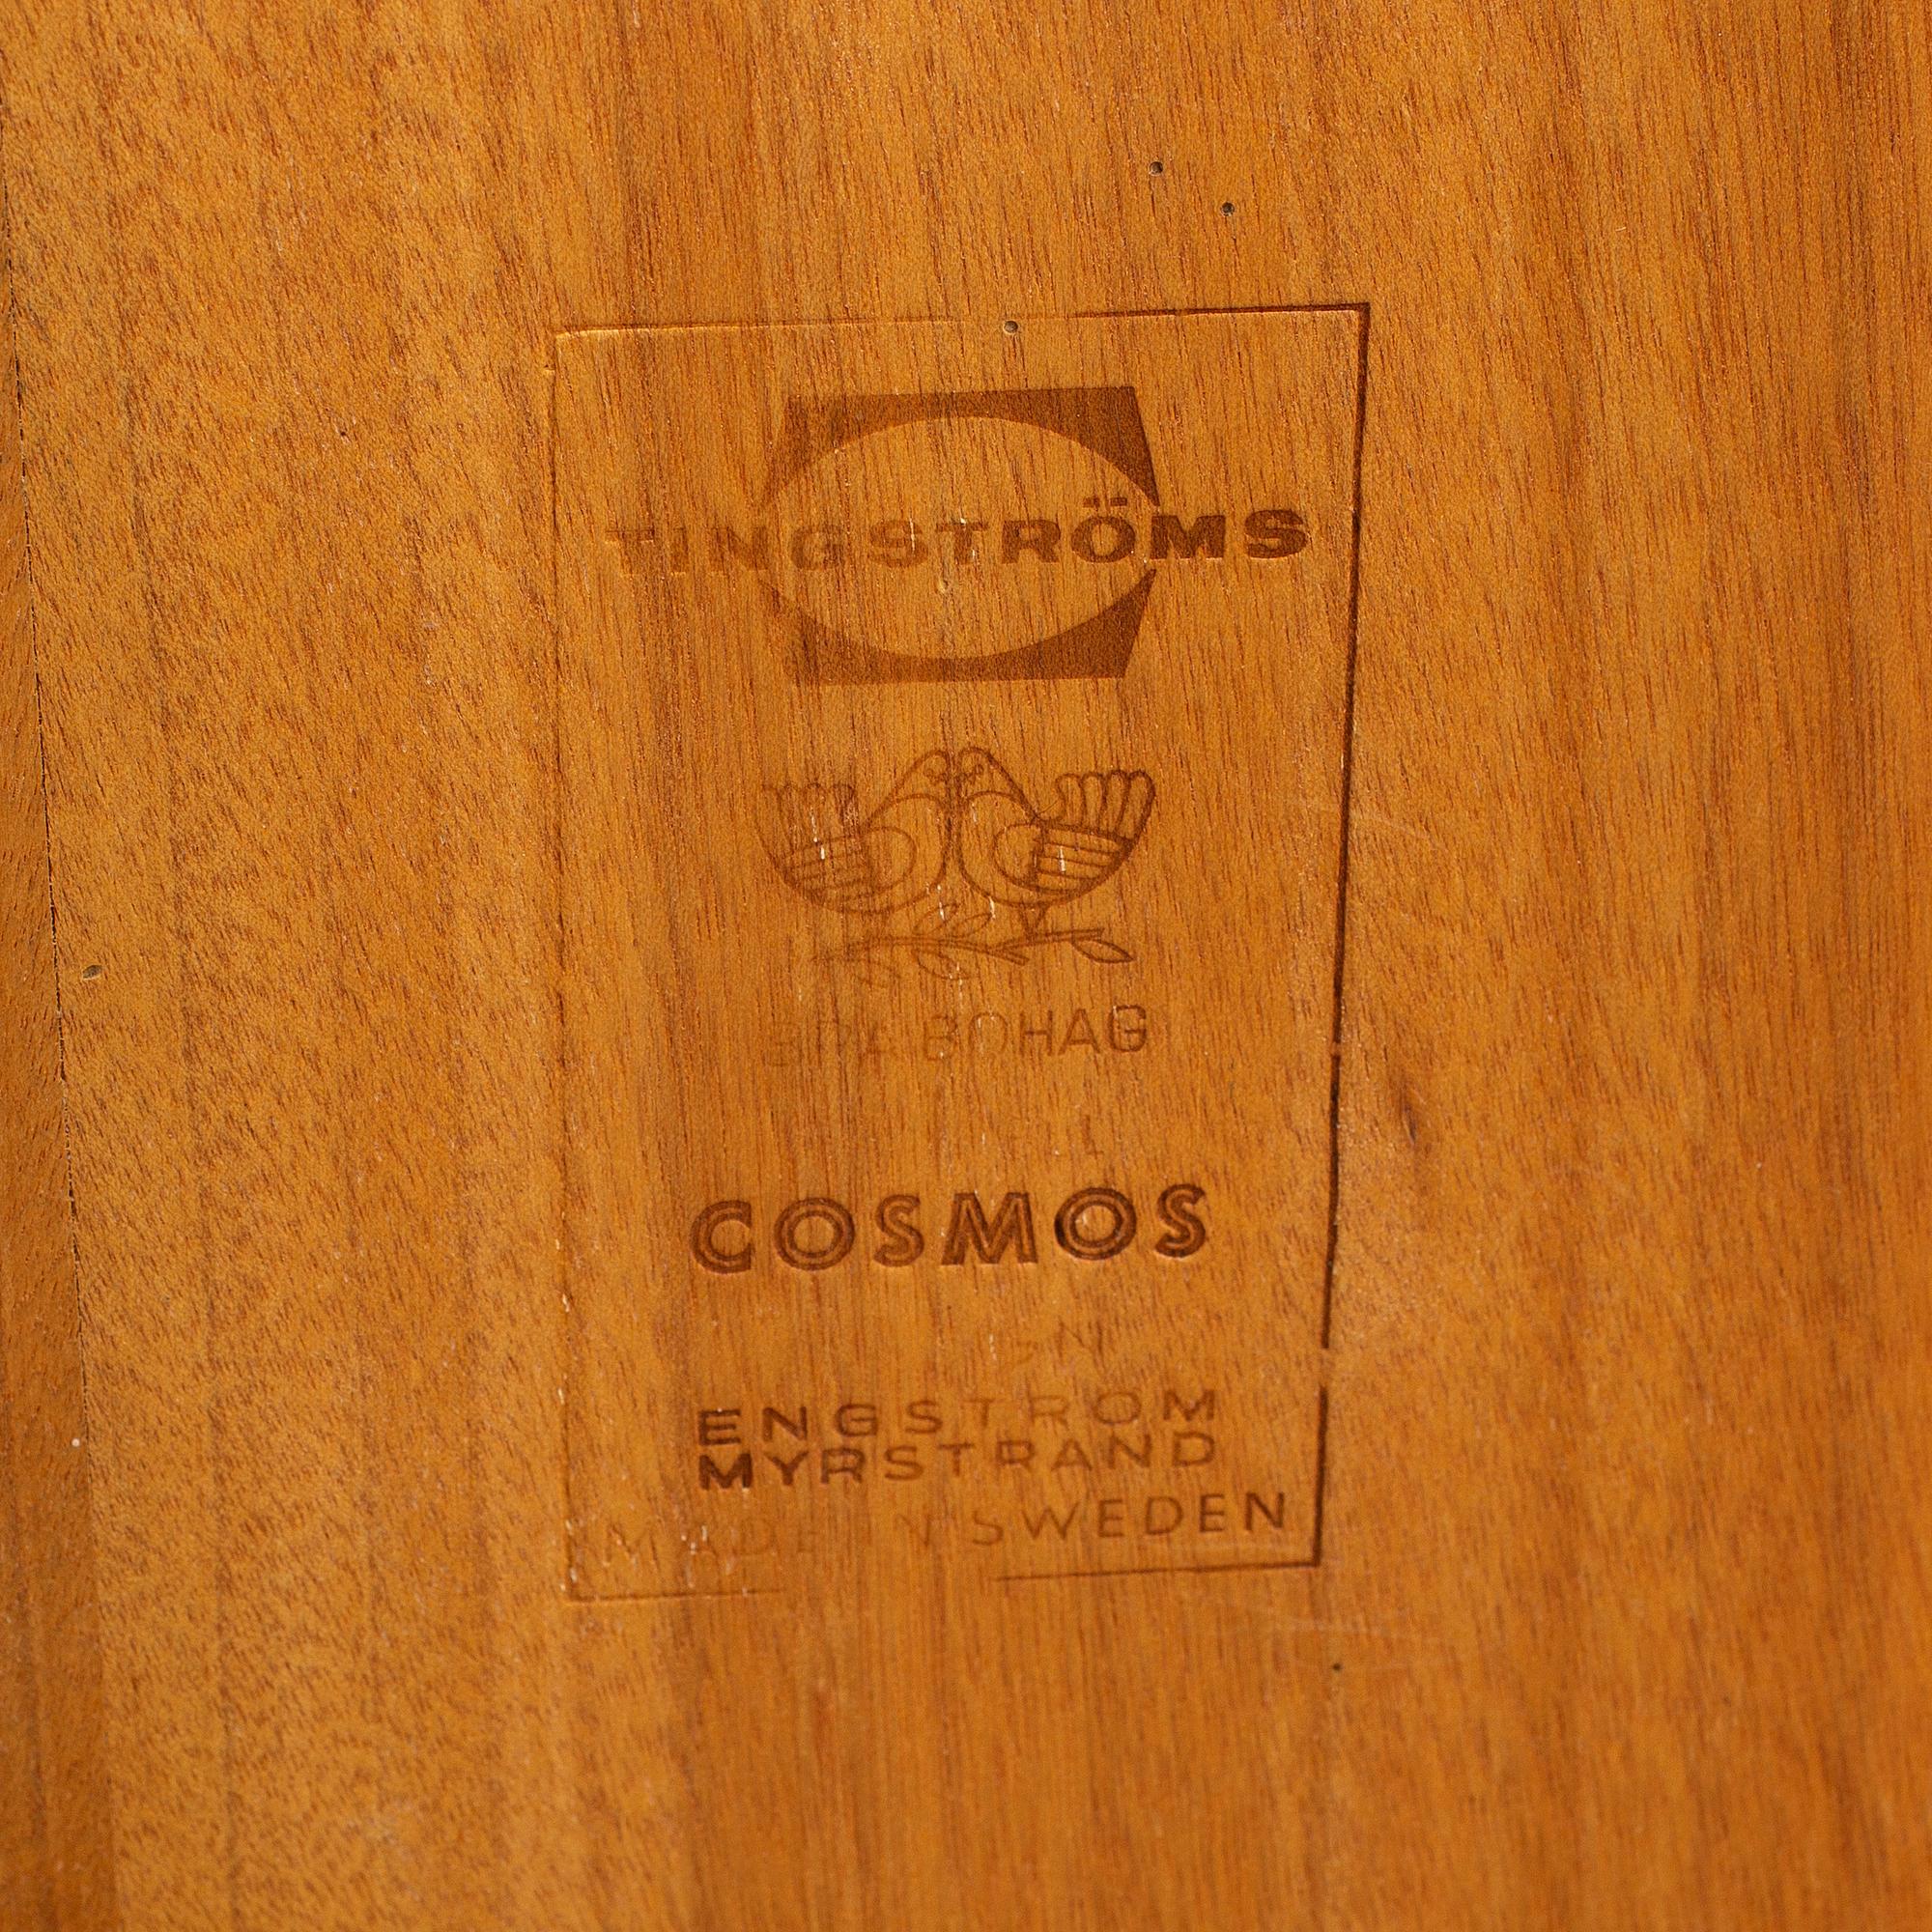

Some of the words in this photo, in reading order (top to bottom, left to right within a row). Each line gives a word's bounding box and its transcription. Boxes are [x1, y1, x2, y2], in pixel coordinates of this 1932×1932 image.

[605, 497, 1306, 577] TINGSTRÖMS
[923, 1005, 1148, 1062] BOHAG
[690, 1183, 1207, 1274] COSMOS
[697, 1388, 1216, 1447] ENGSTROM
[697, 1431, 1216, 1490] MYRSTRAND
[971, 1491, 1287, 1547] SWEDEN
